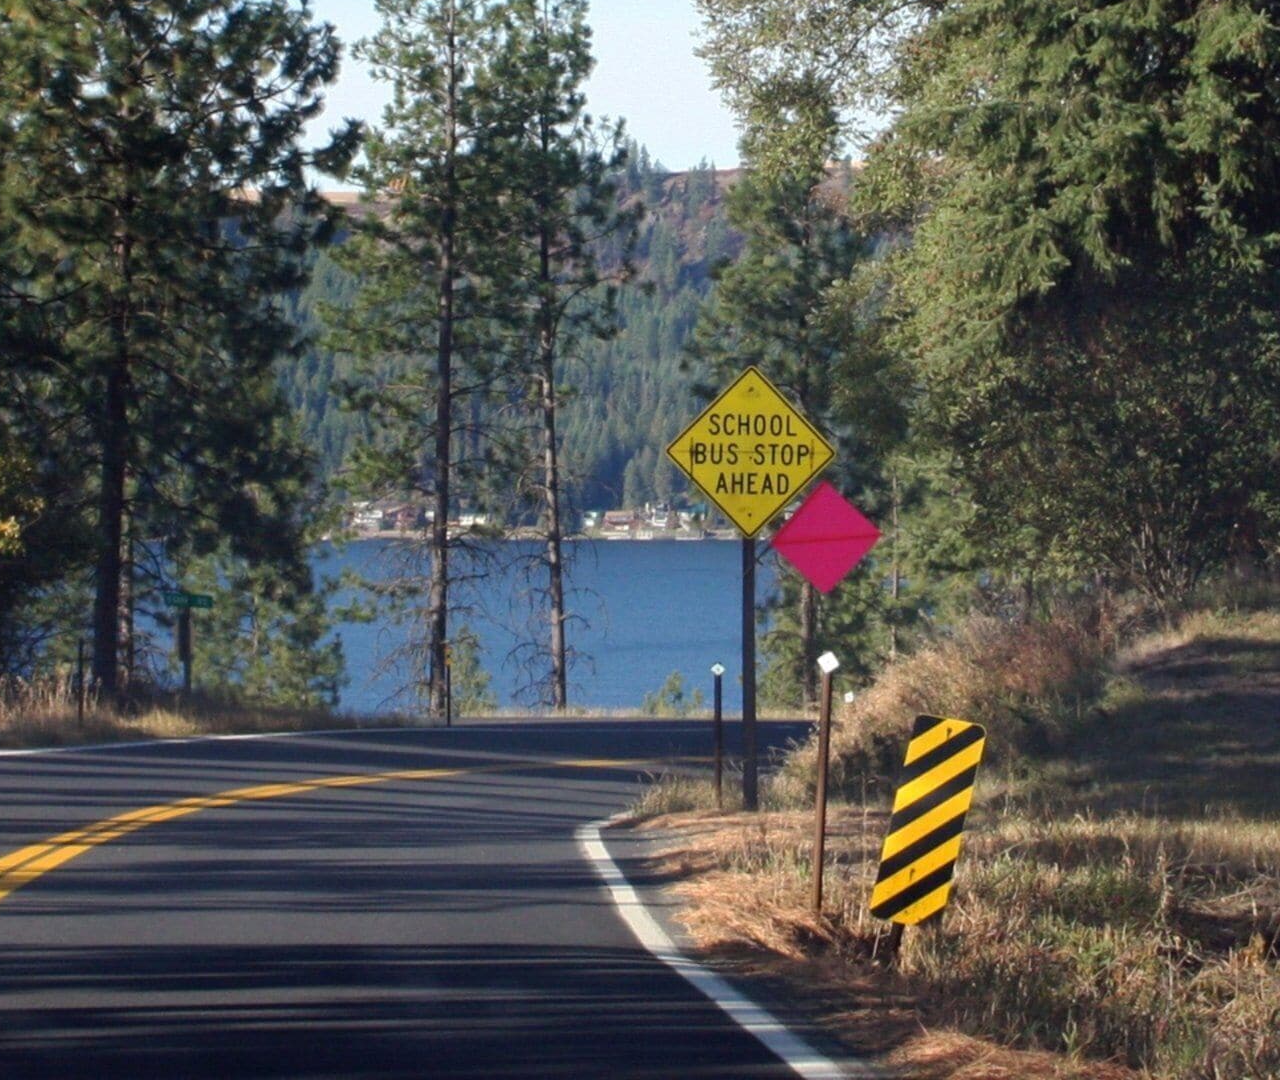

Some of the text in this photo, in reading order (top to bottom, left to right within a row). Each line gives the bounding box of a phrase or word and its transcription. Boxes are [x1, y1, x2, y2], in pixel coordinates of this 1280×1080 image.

[708, 413, 797, 437] SCHOOL
[694, 442, 810, 466] BUS STOP
[716, 472, 789, 495] AHEAD
